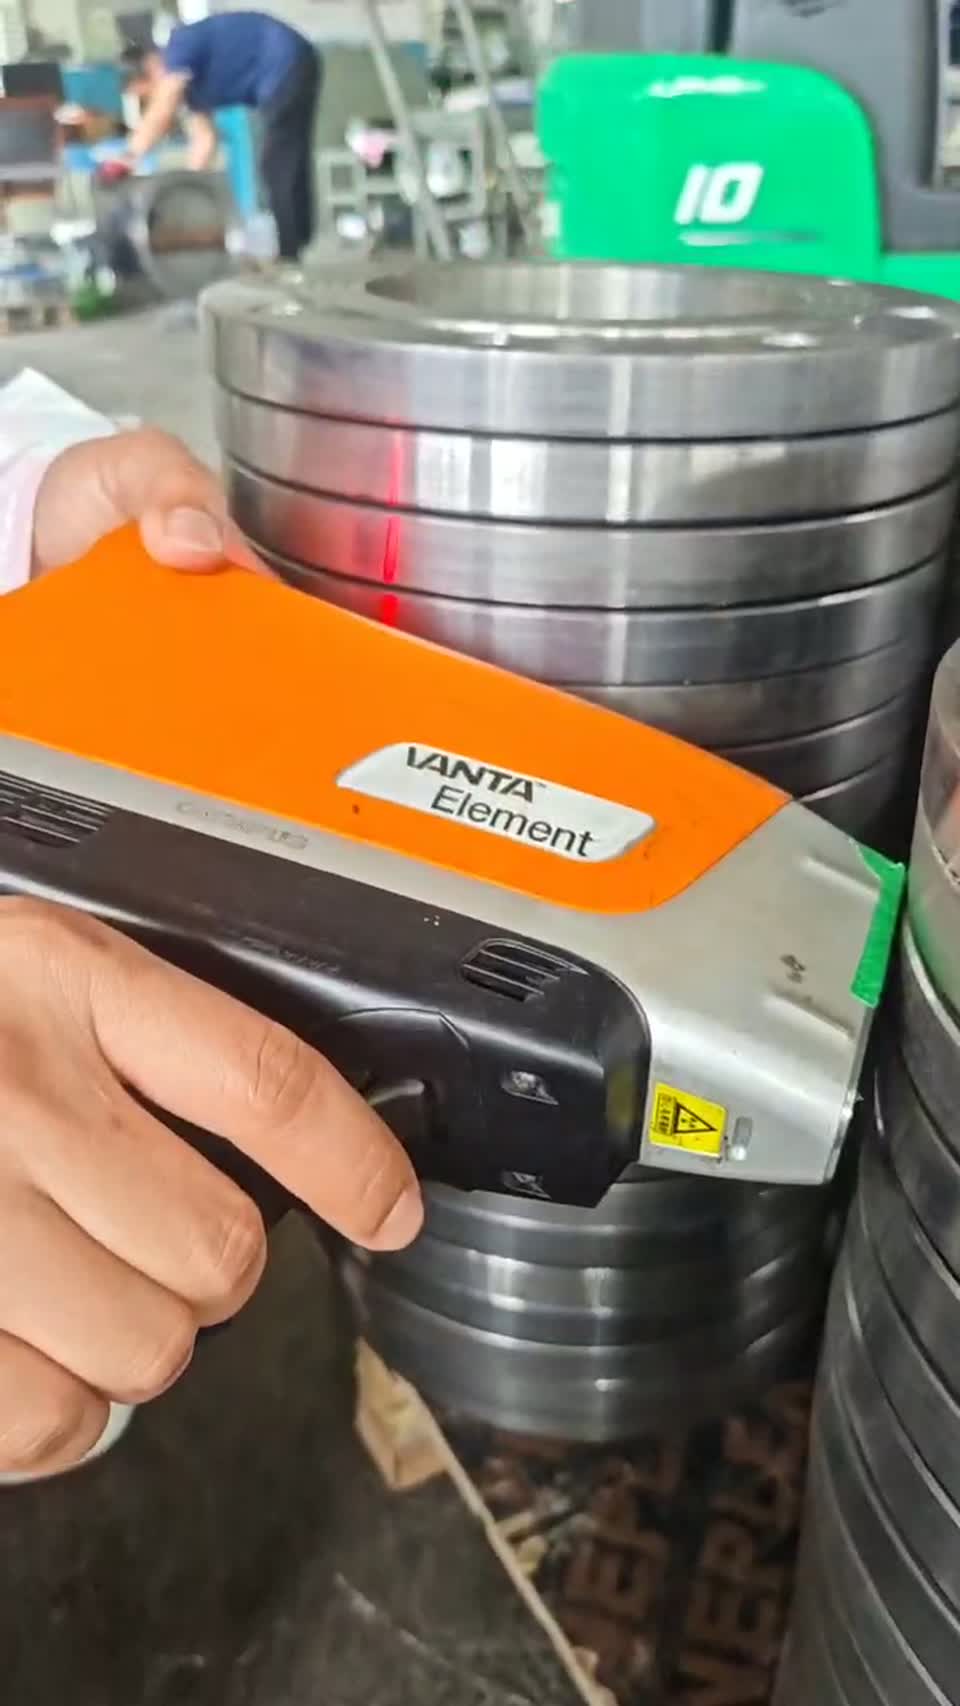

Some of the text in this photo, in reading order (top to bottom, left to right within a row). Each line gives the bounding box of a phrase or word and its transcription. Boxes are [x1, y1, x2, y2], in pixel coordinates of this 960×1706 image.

[674, 161, 763, 225] 10
[406, 746, 535, 803] VANTA
[431, 785, 594, 857] Element
